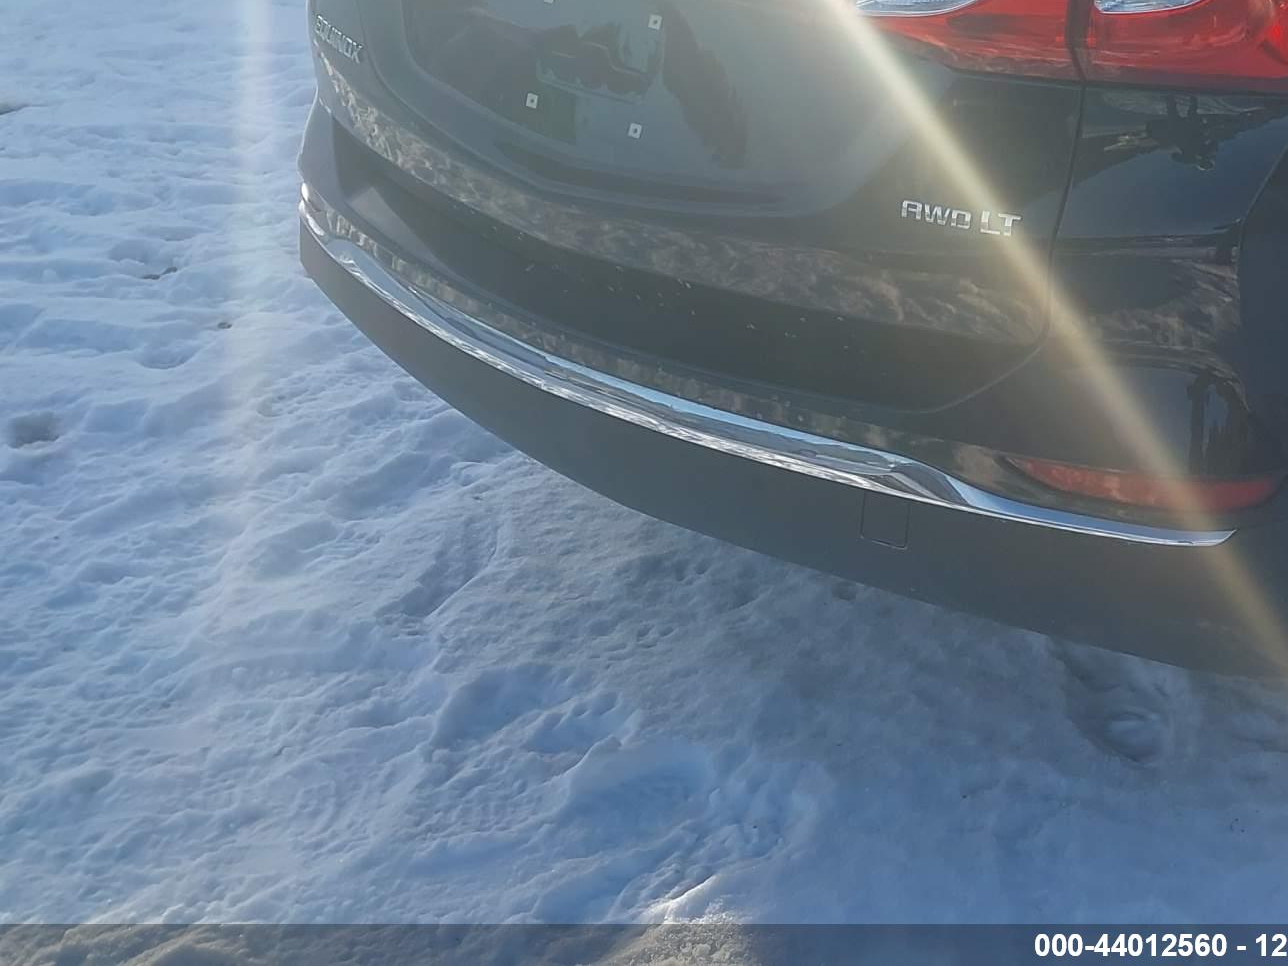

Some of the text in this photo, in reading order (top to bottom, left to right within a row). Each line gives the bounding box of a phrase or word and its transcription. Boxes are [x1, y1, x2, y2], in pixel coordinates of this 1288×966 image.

[315, 14, 363, 64] EQUINOX
[900, 199, 1022, 237] AWD LT
